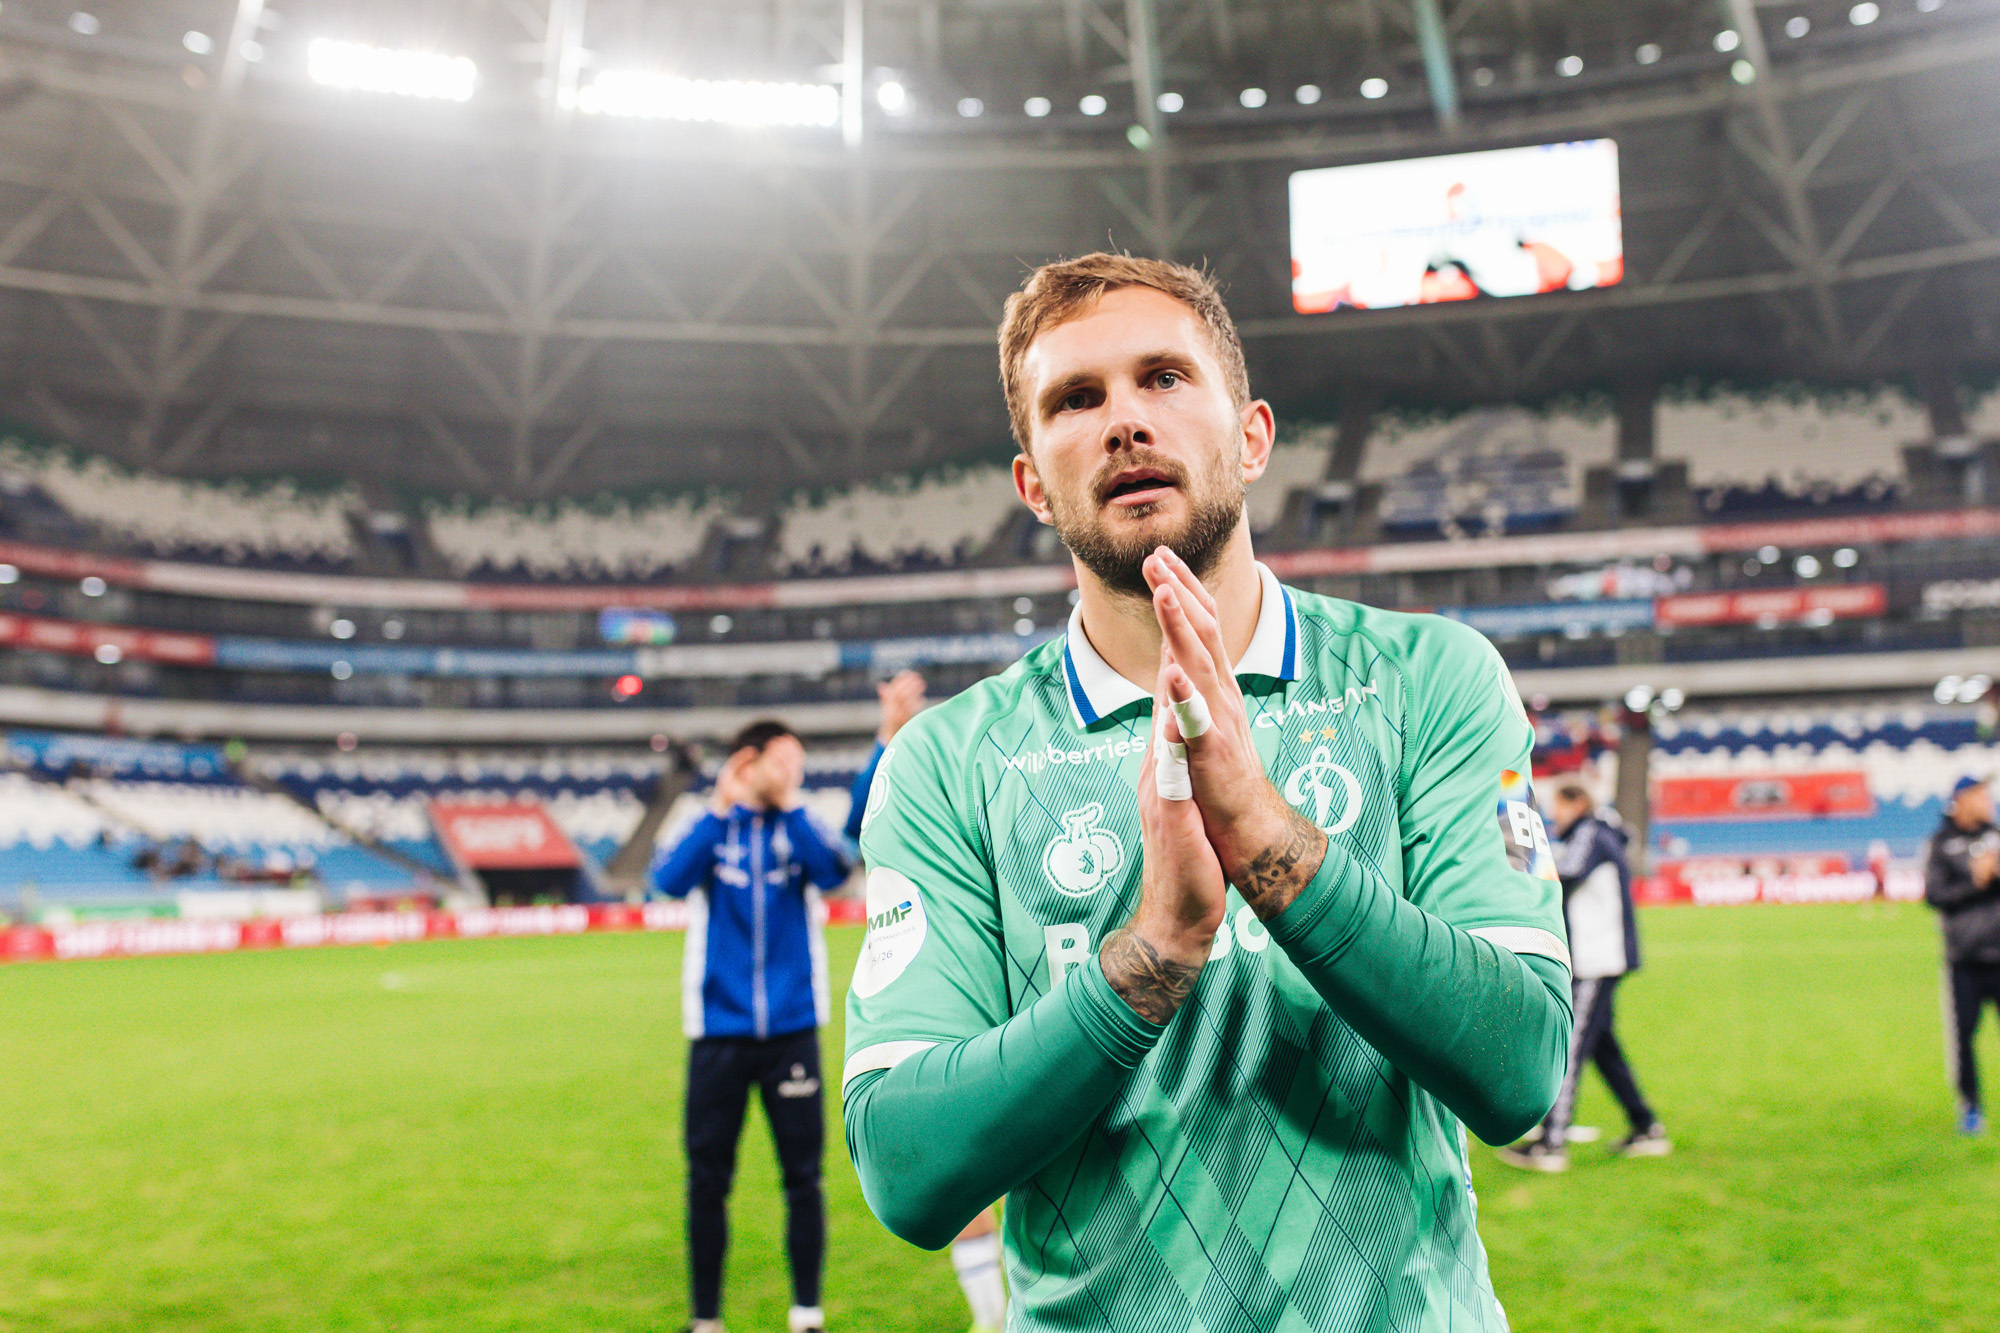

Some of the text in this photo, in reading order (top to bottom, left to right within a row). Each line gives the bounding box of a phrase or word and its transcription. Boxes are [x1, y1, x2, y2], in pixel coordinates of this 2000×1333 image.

[1255, 678, 1377, 729] CHANGAN
[1002, 736, 1147, 774] wildberries
[868, 900, 912, 934] МИР
